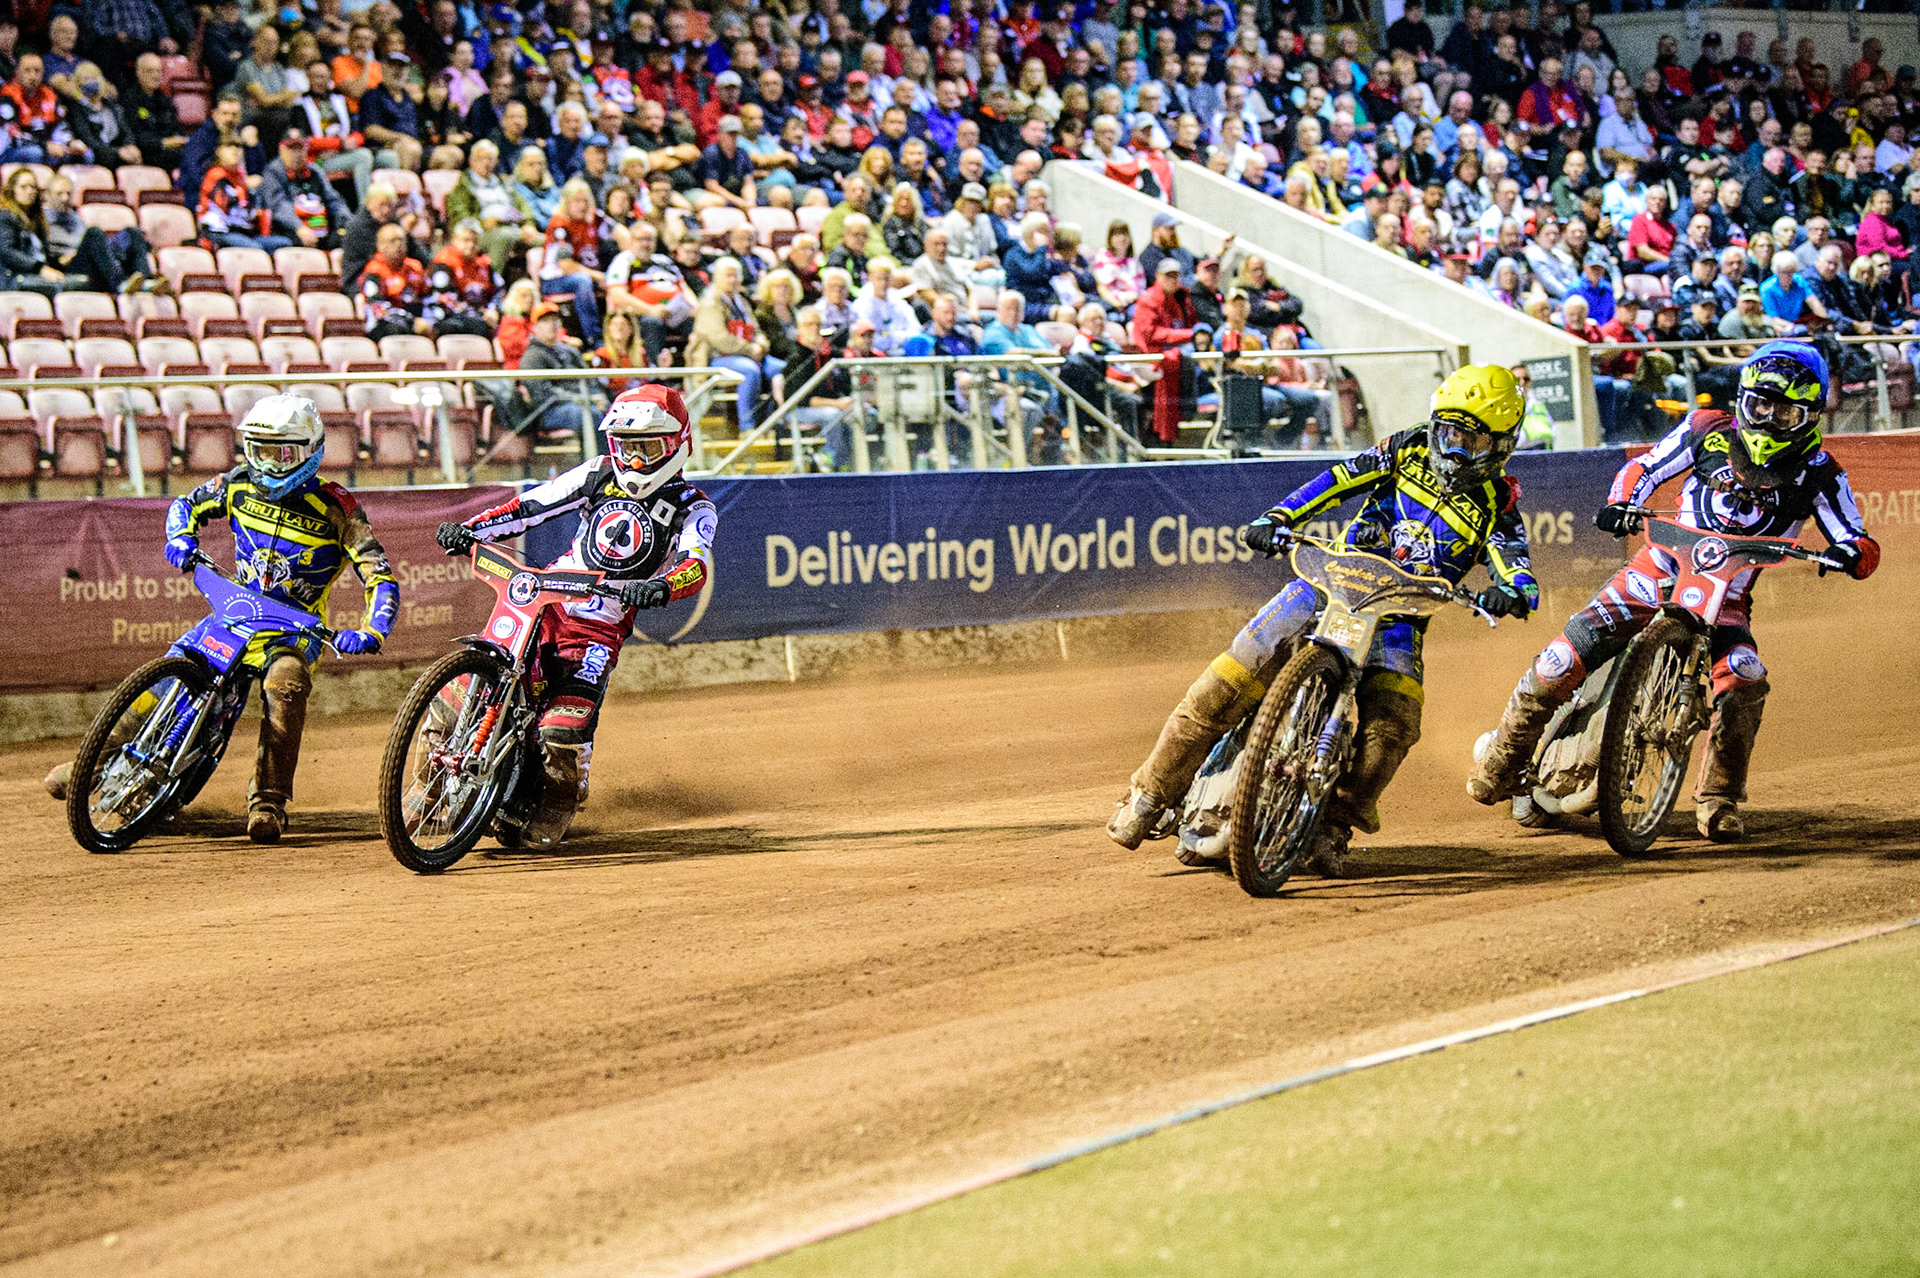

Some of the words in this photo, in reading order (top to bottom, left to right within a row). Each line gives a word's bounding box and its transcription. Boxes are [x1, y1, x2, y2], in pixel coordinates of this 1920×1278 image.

[598, 502, 625, 518] BELLE
[627, 503, 644, 519] VUE
[640, 520, 652, 544] ACES
[299, 550, 314, 566] 3
[765, 526, 995, 594] Delivering
[1007, 516, 1137, 575] World
[1149, 514, 1255, 568] Class
[60, 573, 128, 603] Proud
[133, 576, 159, 600] to
[403, 601, 454, 627] Team
[197, 644, 230, 664] FILTRATION
